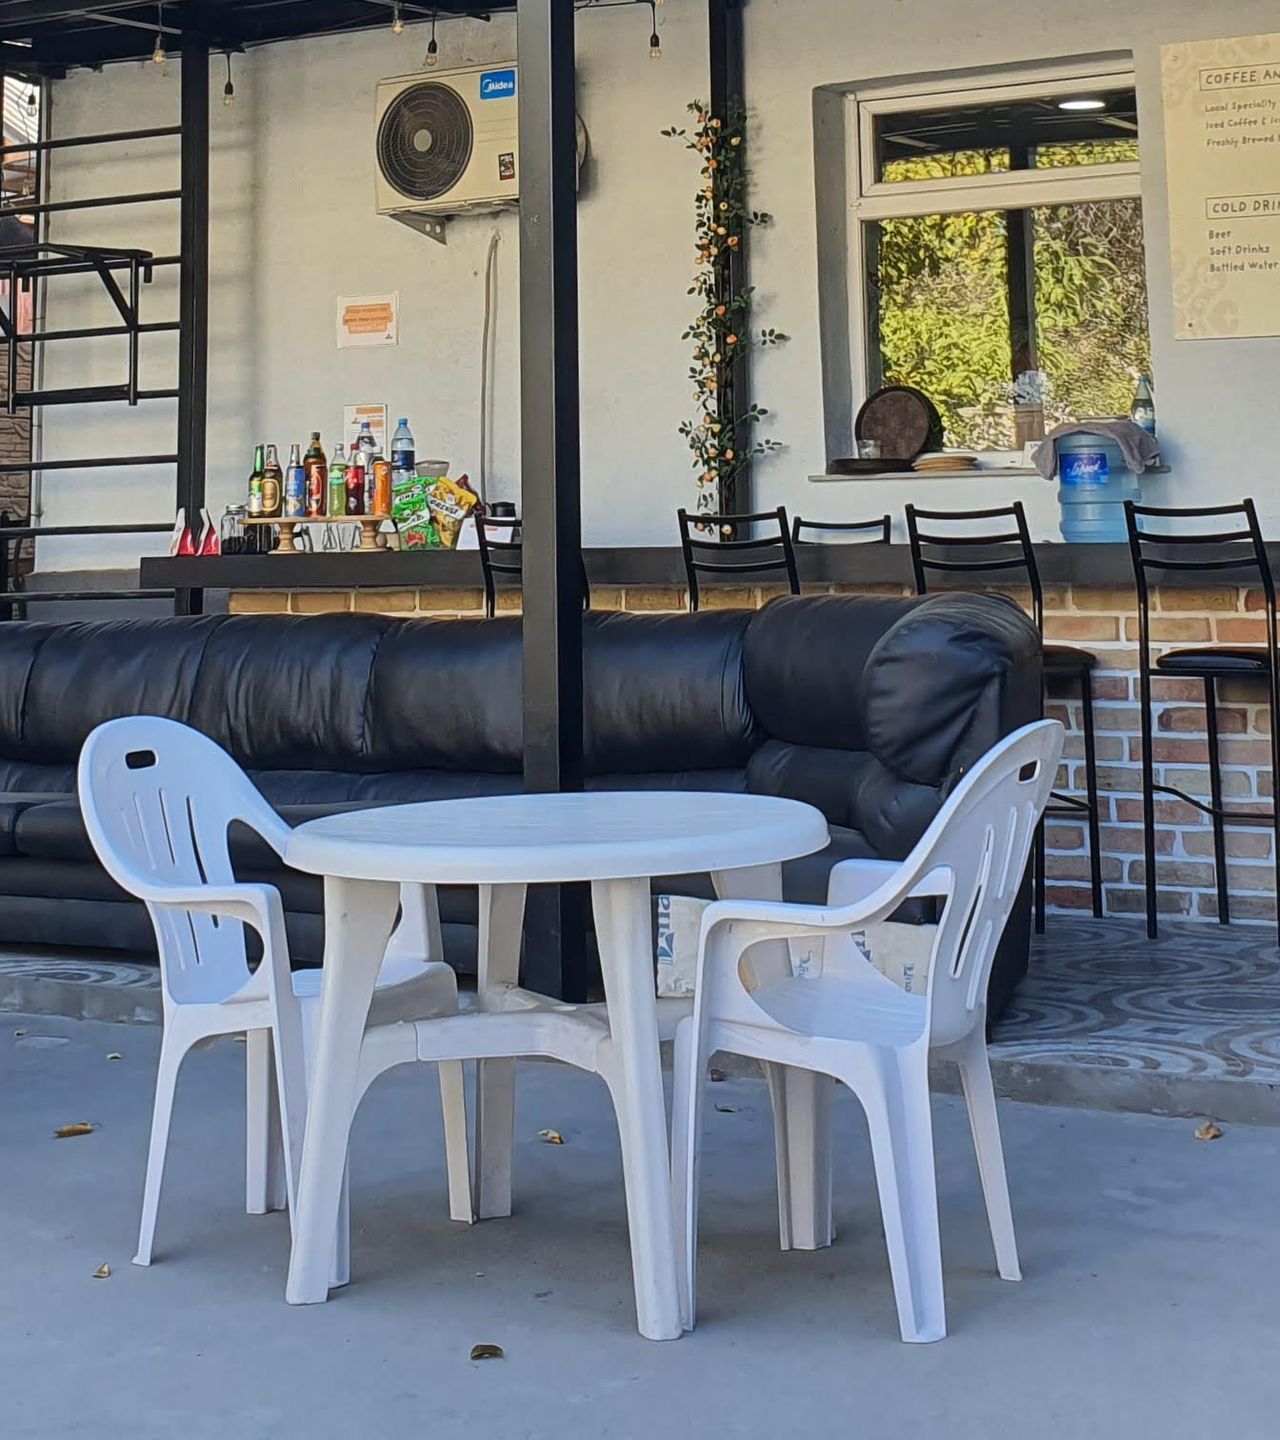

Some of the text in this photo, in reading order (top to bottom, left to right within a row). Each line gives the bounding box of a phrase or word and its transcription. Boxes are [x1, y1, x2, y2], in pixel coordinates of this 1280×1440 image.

[1205, 70, 1257, 85] COFFEE
[484, 79, 513, 91] Midea
[1205, 102, 1228, 113] Local
[1232, 99, 1277, 112] Speciality
[1206, 120, 1225, 130] Iced
[1227, 117, 1258, 128] Coffee
[1206, 138, 1239, 148] Freshly
[1242, 134, 1274, 145] Brewed
[1212, 201, 1247, 213] COLD
[1208, 230, 1231, 240] Beer
[1209, 244, 1270, 256] Soft Drinks
[1209, 261, 1278, 273] Bottled Water
